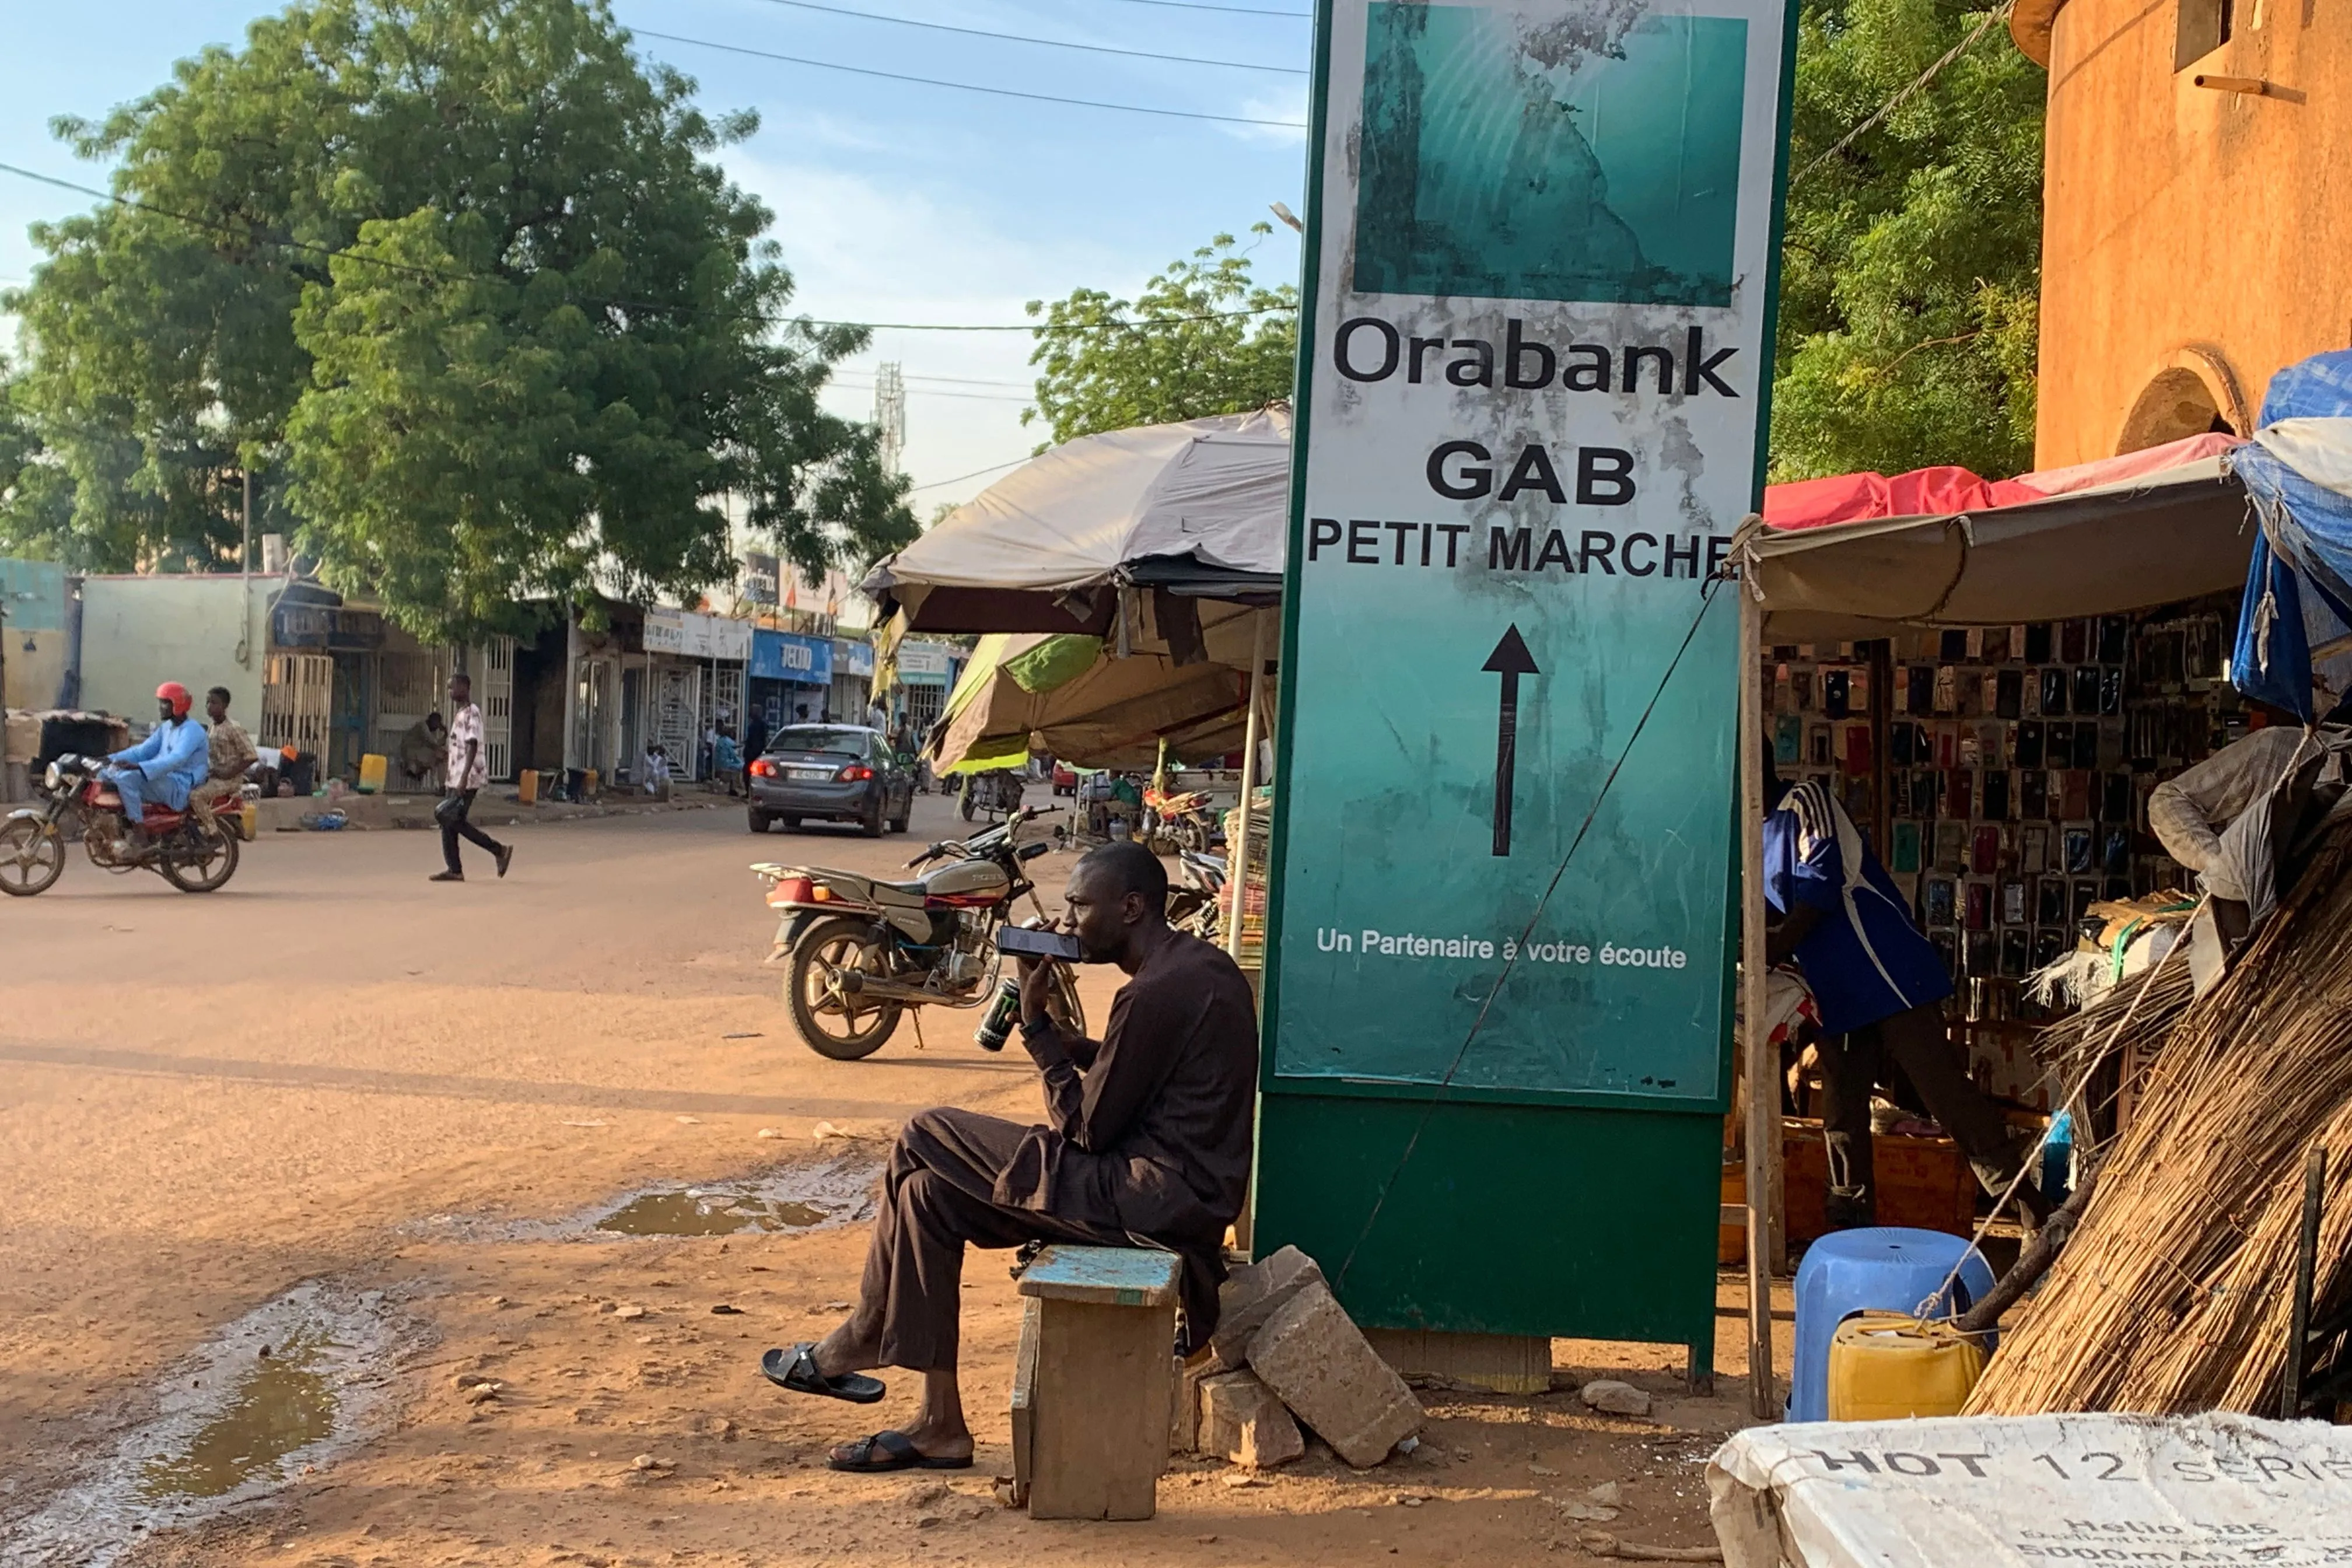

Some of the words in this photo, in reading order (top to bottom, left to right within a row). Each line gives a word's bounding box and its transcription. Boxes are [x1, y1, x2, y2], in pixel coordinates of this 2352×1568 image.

[1334, 317, 1741, 398] Orabank
[1426, 440, 1636, 506] GAB
[1308, 519, 1470, 566] PETIT
[1317, 928, 1352, 953] Un
[1361, 930, 1494, 959] Partenaire
[1527, 943, 1591, 964] votre
[1600, 942, 1688, 970] écoute
[1811, 1450, 1991, 1478] HOT
[2033, 1451, 2139, 1482] 12
[2063, 1518, 2182, 1535] Helio
